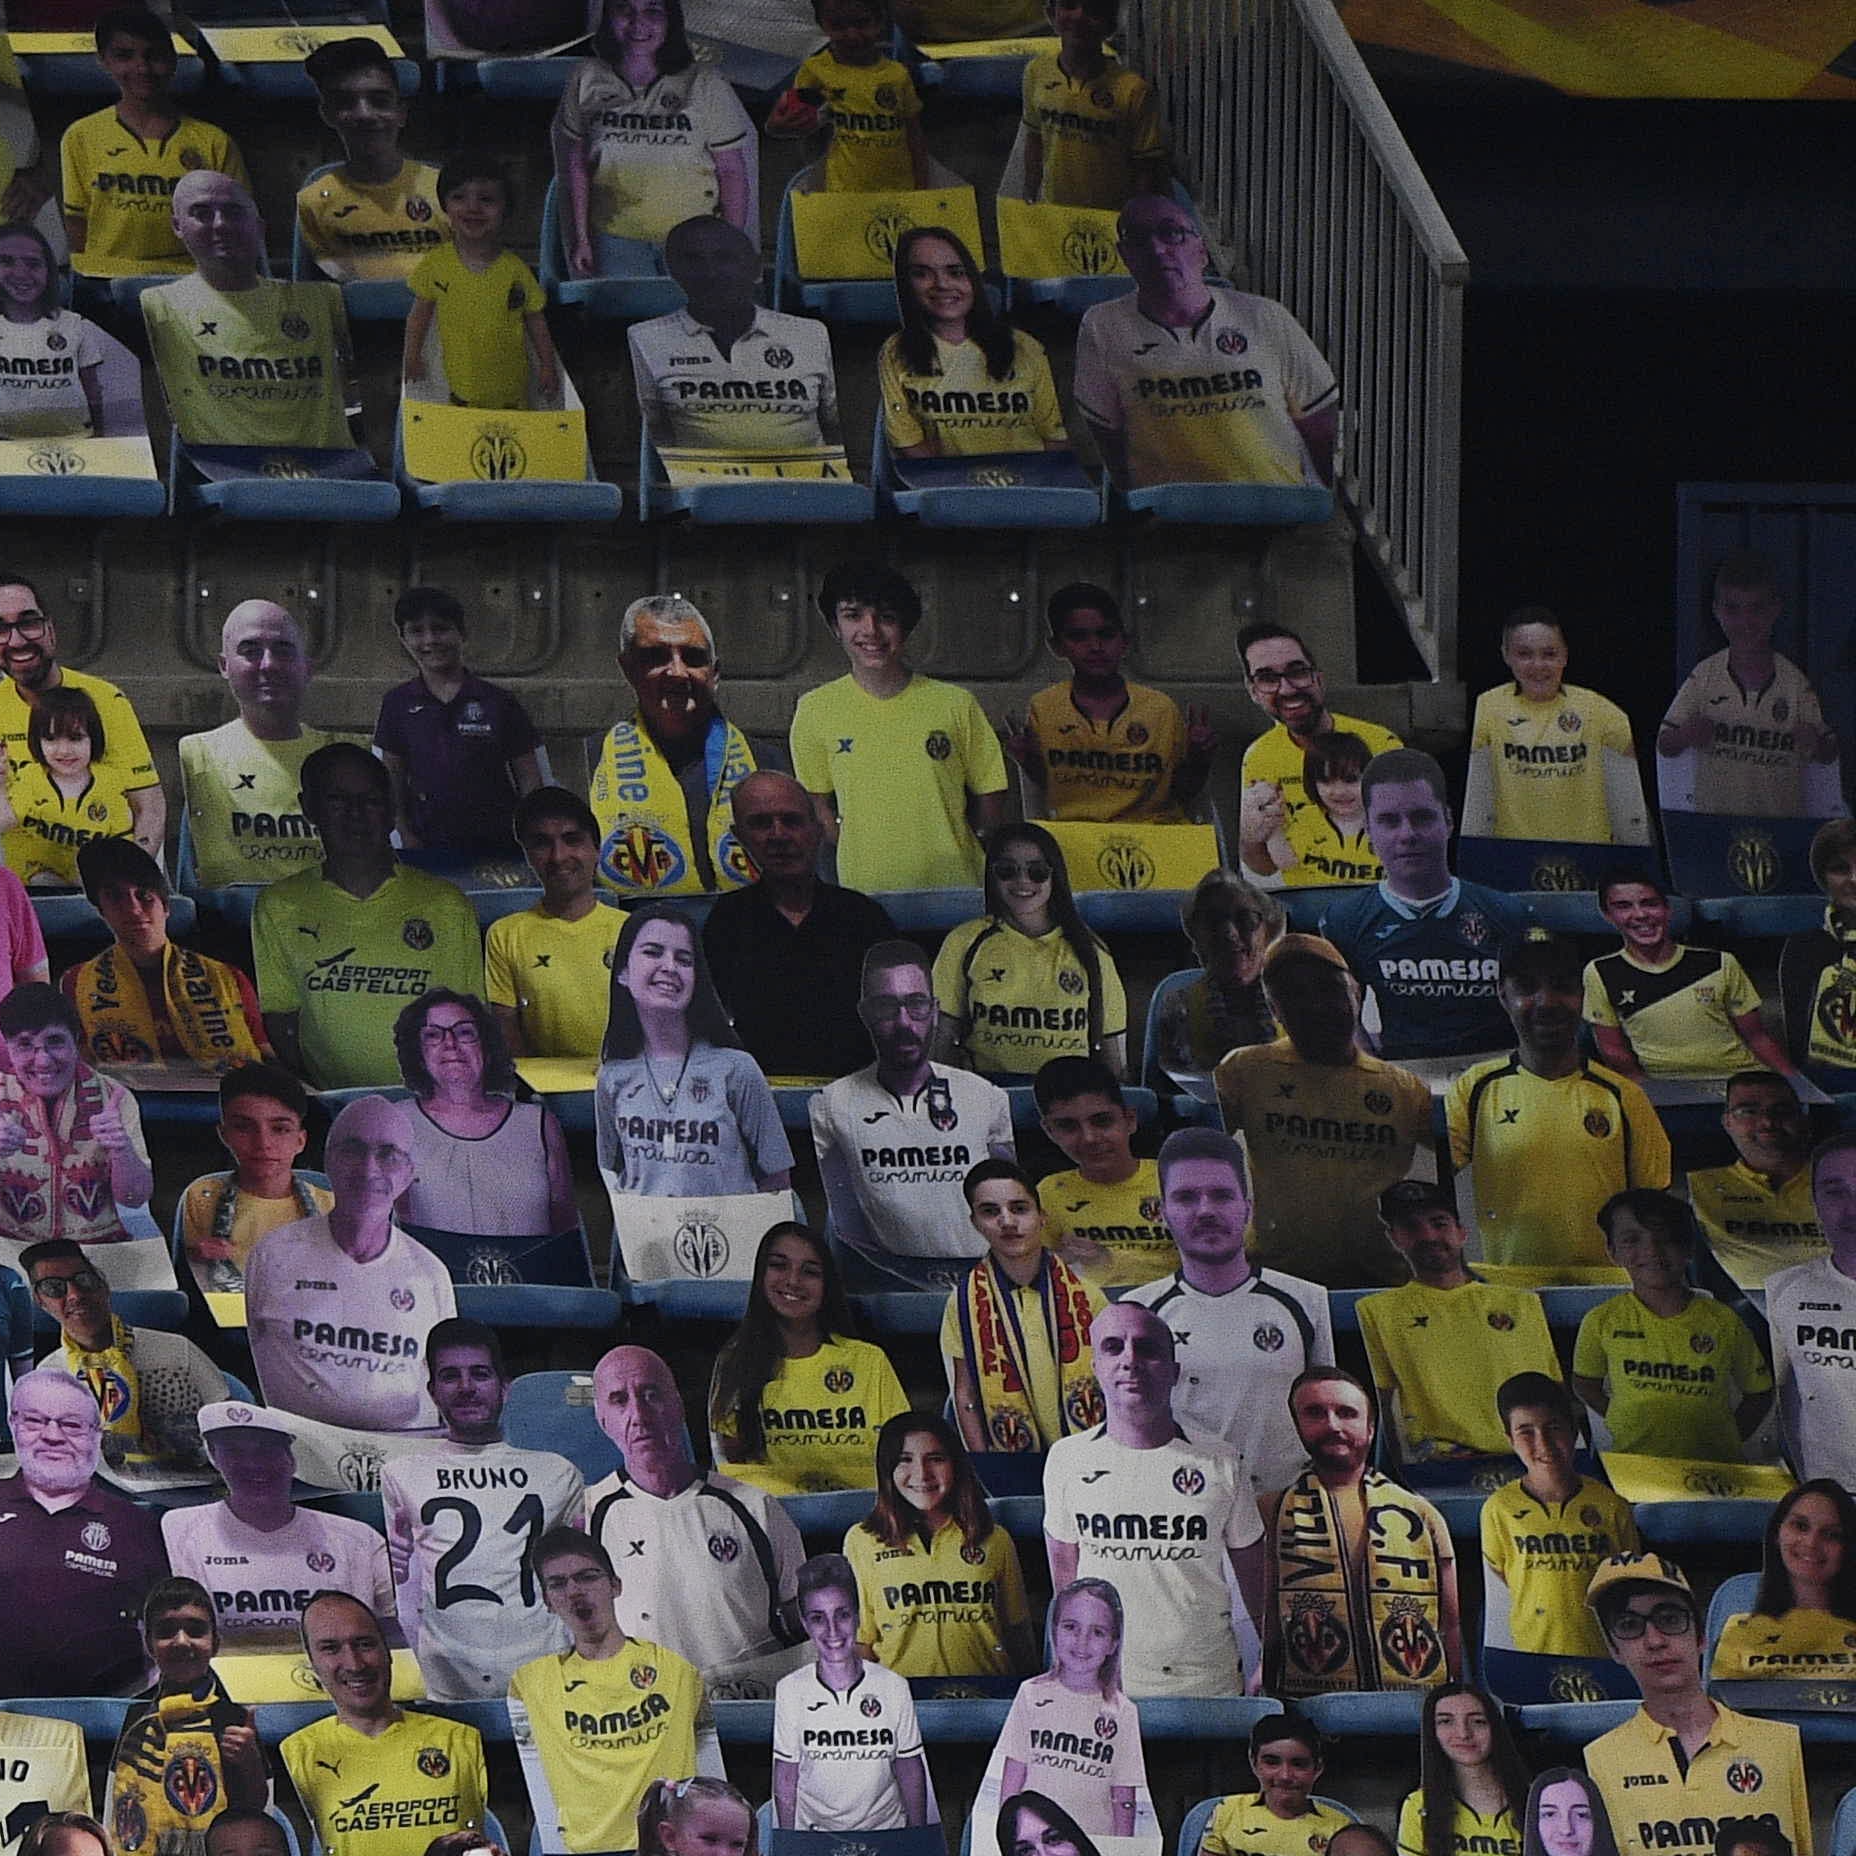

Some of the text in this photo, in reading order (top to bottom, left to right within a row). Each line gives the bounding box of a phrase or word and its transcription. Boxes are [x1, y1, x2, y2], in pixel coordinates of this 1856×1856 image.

[198, 354, 323, 381] PAMESA
[679, 380, 808, 402] PAMESA
[1137, 369, 1263, 398] PAMESA
[906, 389, 1030, 414] PAMESA
[1048, 748, 1164, 772] PAMESA
[328, 962, 433, 980] AEROPORT
[1379, 959, 1499, 980] PAMESA
[308, 973, 428, 995] CASTELLO
[972, 1004, 1088, 1030] PAMESA
[861, 1145, 970, 1168] PAMESA
[293, 1319, 421, 1356] PAMESA
[436, 1466, 528, 1490] BRUNO
[1076, 1514, 1208, 1541] PAMESA
[420, 1495, 546, 1608] 21
[887, 1580, 994, 1610] PAMESA
[563, 1693, 671, 1733] PAMESA
[803, 1729, 893, 1746] PAMESA
[1030, 1728, 1114, 1765] PAMESA
[353, 1795, 460, 1815] AEROPORT
[334, 1808, 458, 1832] CASTELLO
